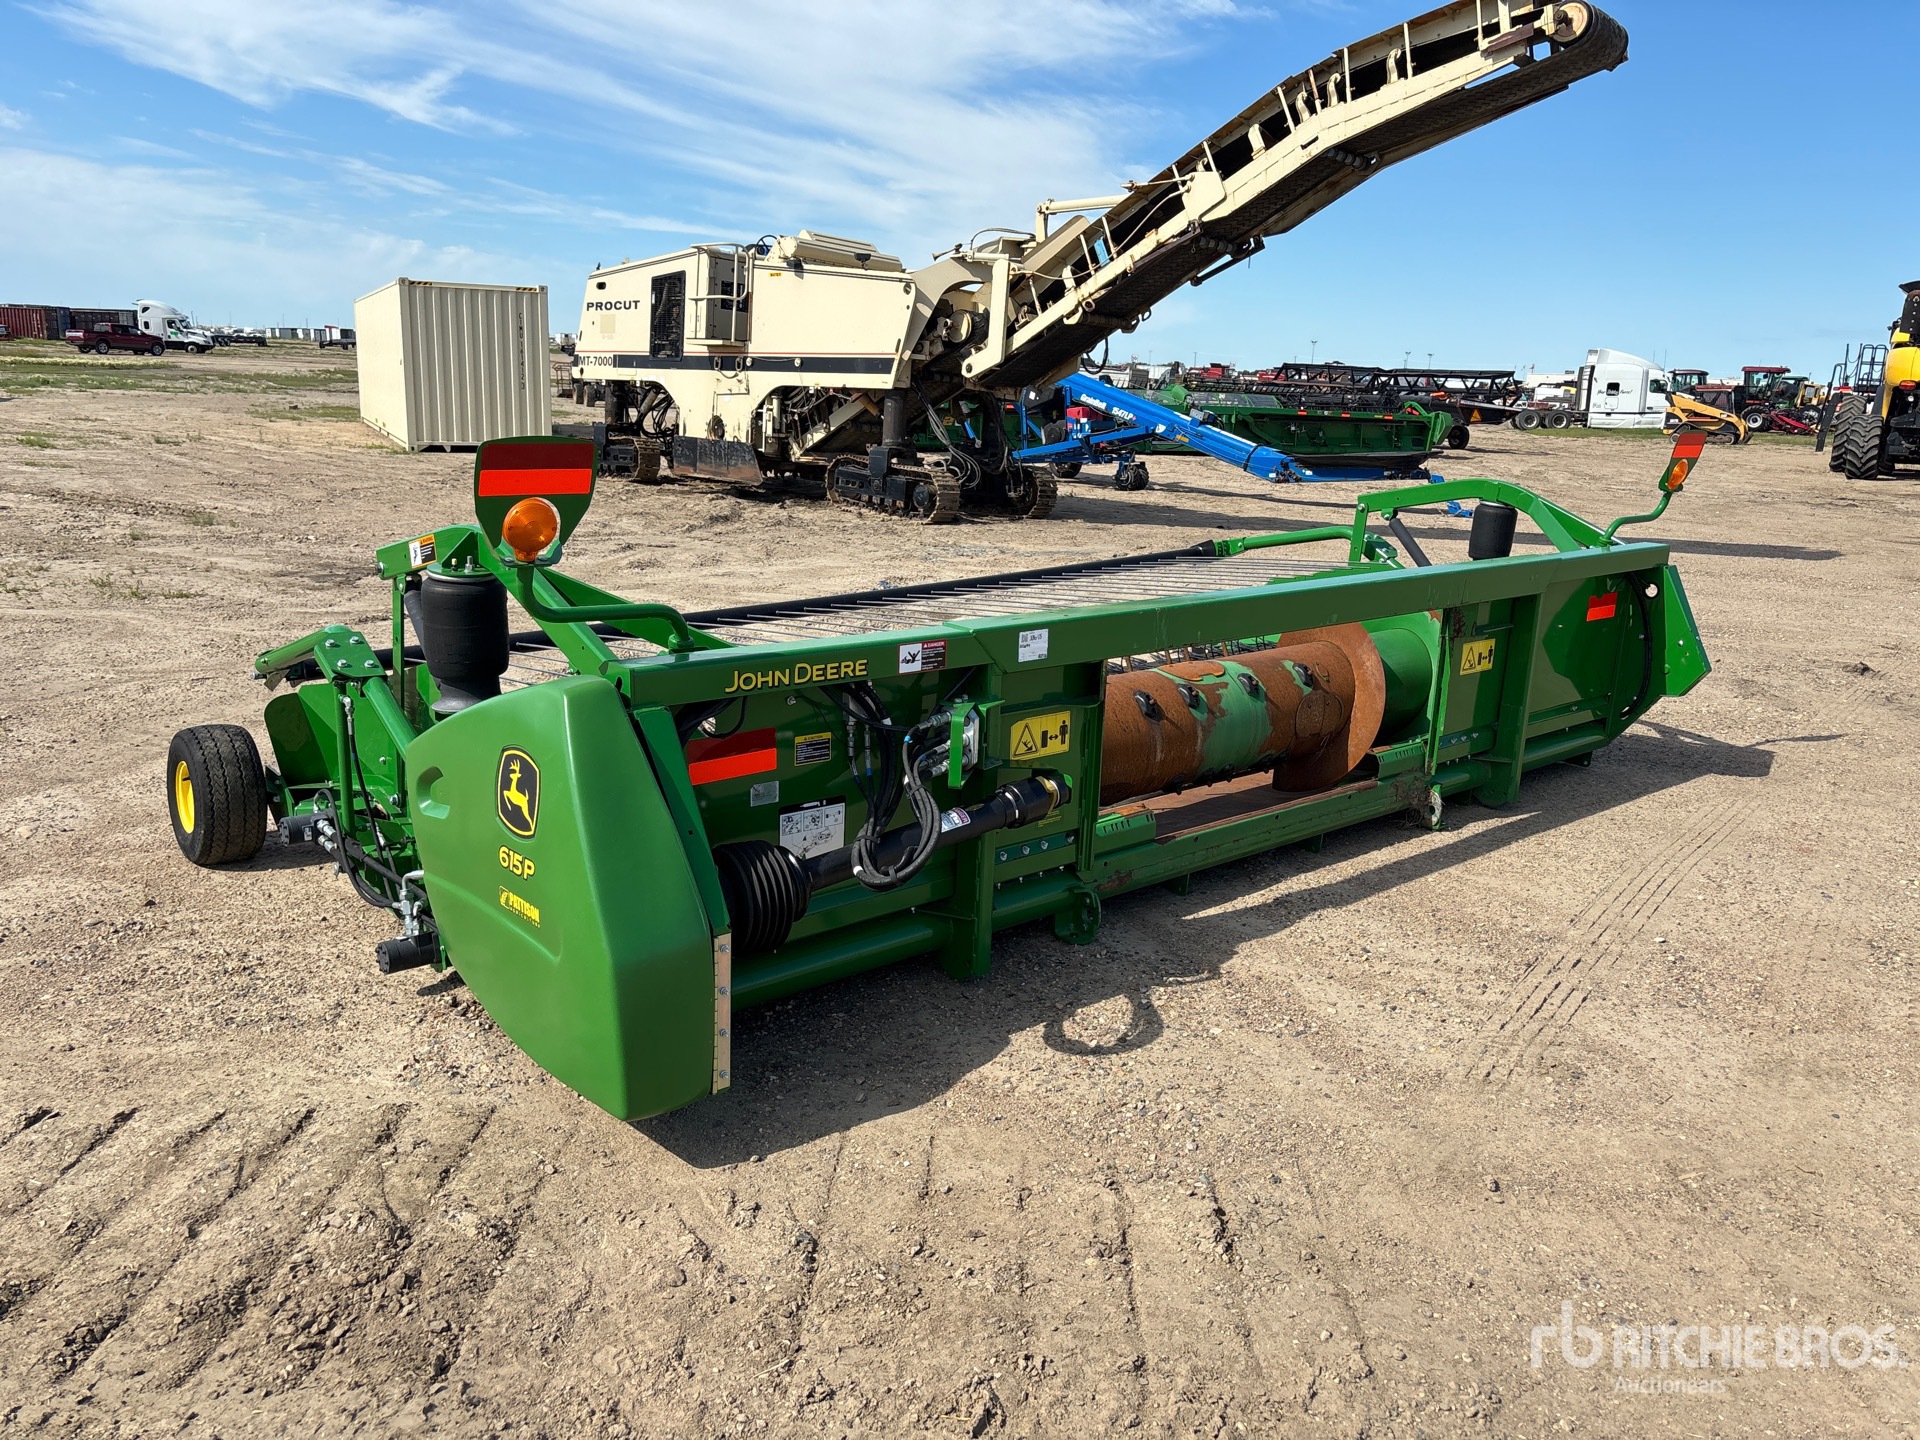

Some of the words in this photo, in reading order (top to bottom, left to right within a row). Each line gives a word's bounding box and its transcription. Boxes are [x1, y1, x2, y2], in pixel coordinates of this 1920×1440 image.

[587, 300, 640, 311] PROCUT
[579, 356, 613, 367] MT-7000
[724, 668, 790, 693] JOHN
[794, 659, 868, 684] DEERE
[499, 845, 535, 881] 615P
[509, 891, 540, 923] PATTISON
